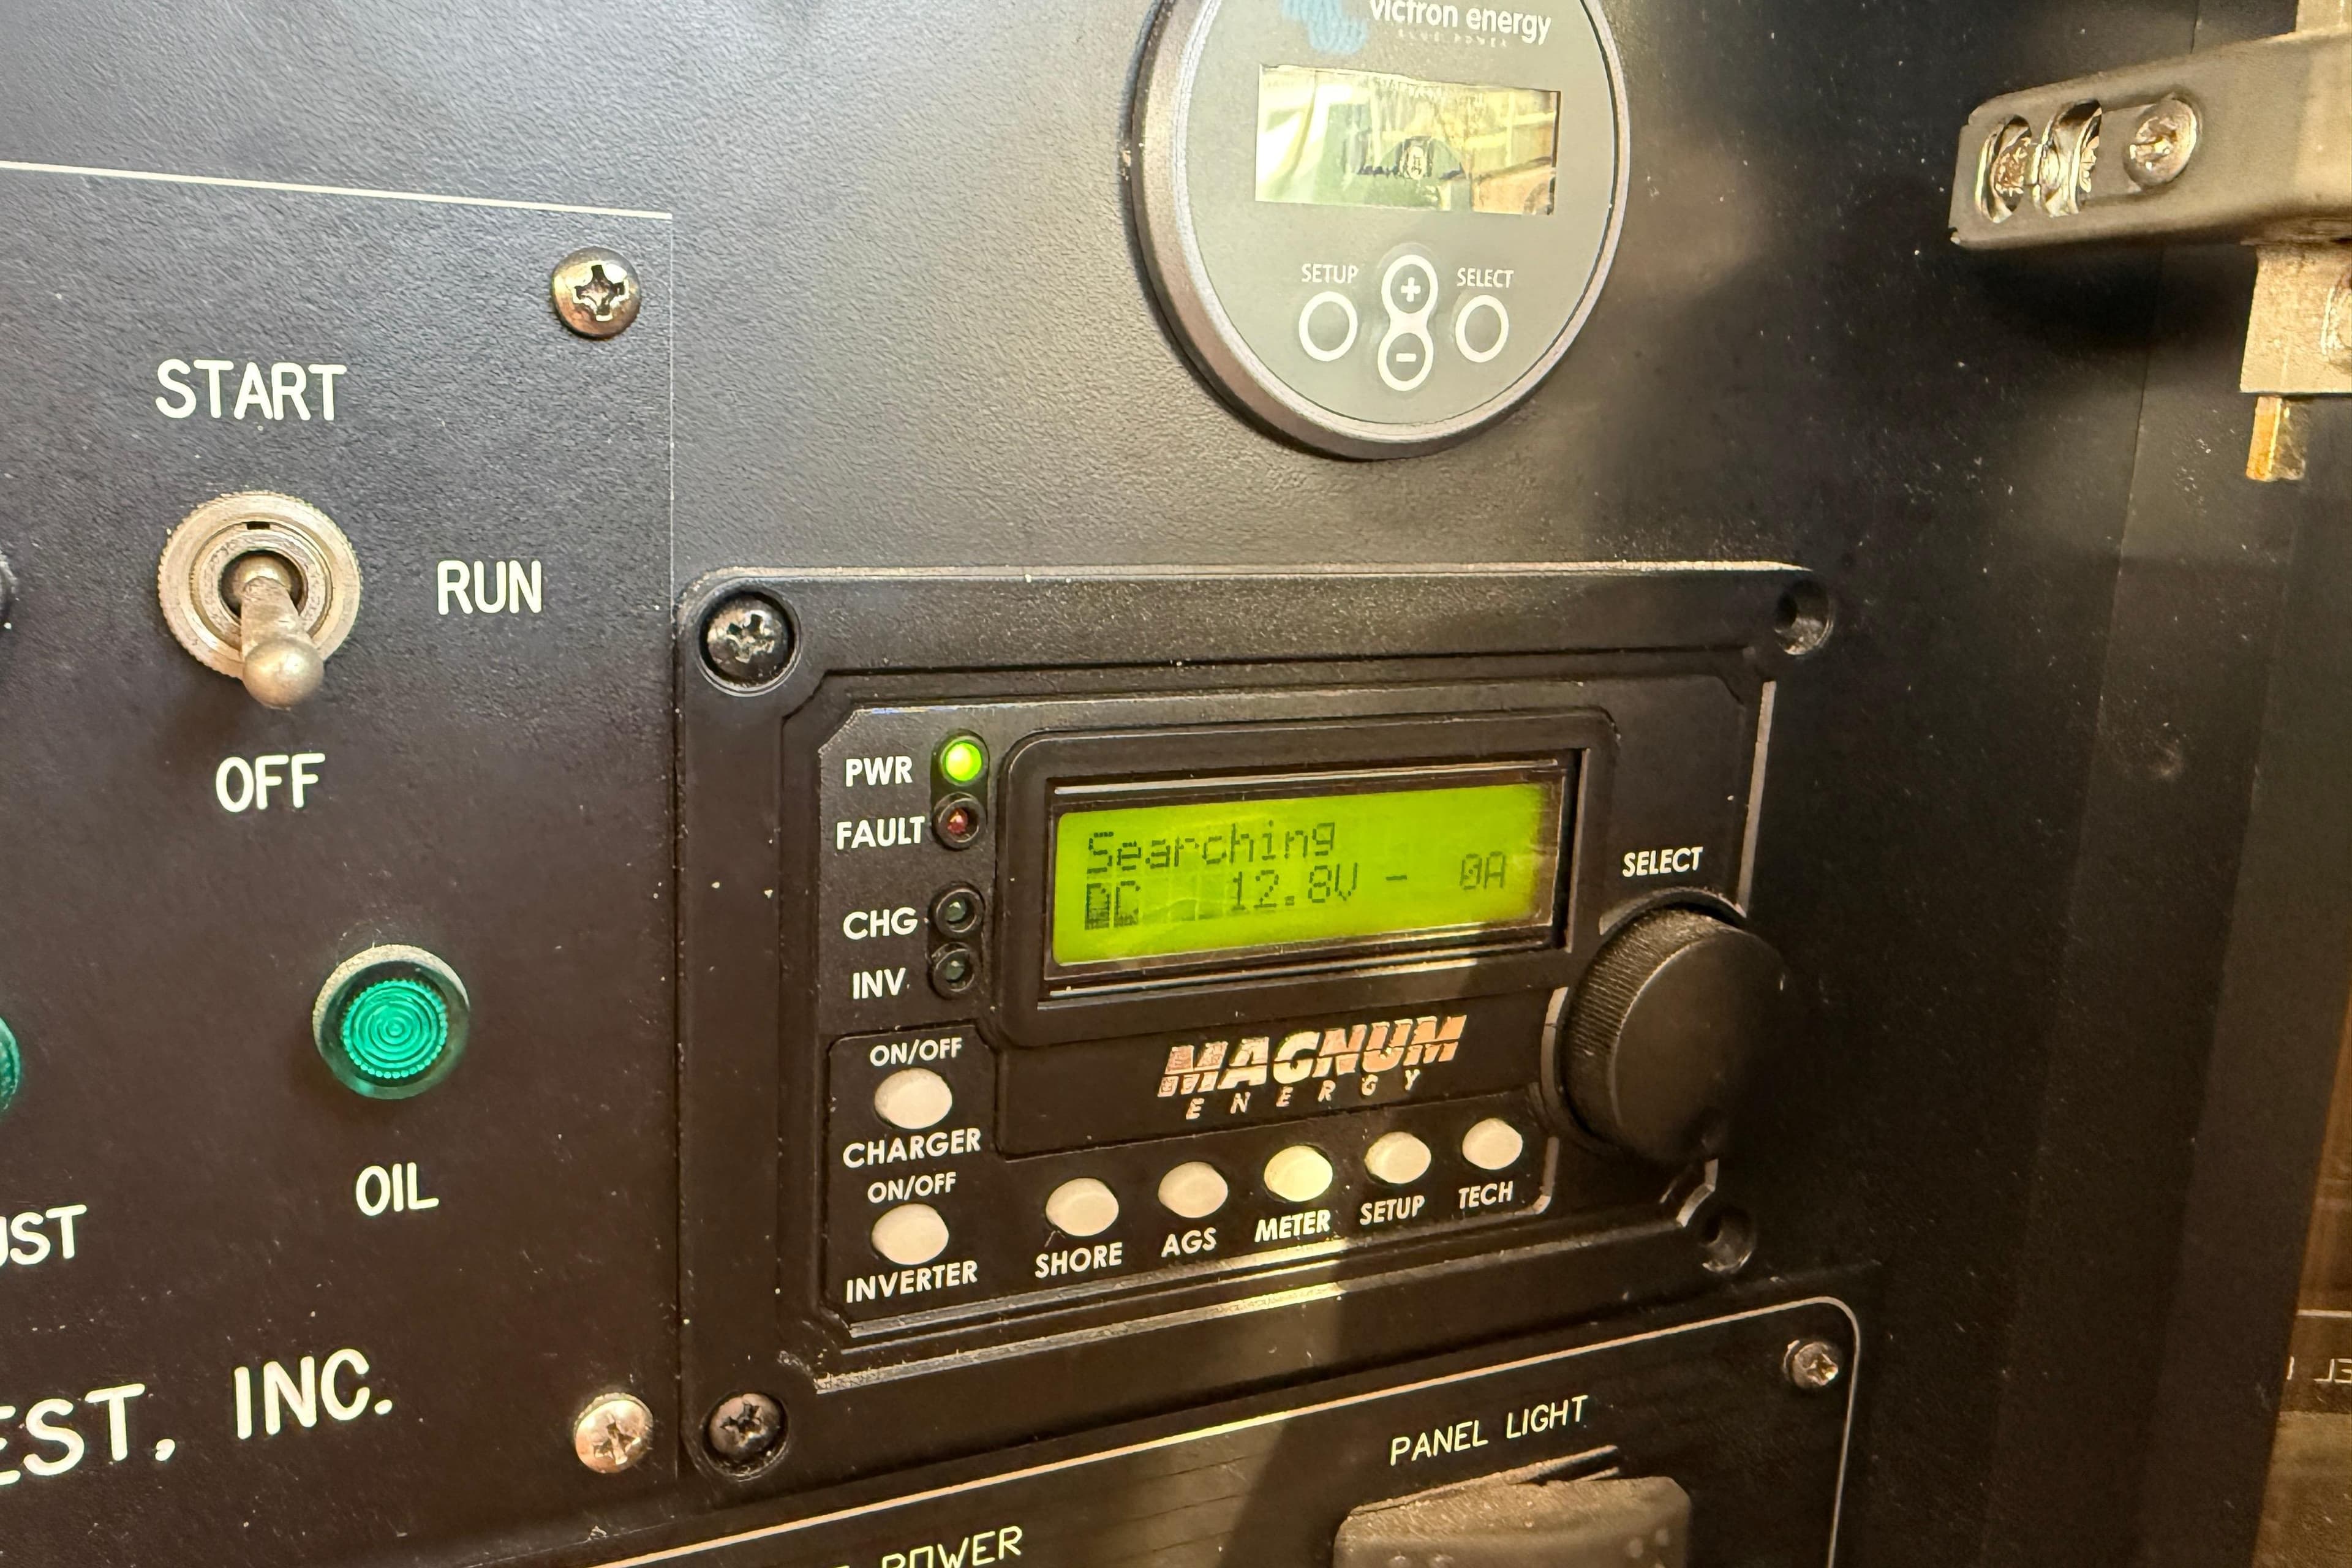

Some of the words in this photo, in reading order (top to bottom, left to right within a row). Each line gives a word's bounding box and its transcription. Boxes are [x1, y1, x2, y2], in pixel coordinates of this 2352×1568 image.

[1464, 7, 1551, 45] energy
[1301, 263, 1359, 284] SETUP
[1457, 267, 1514, 288] SELECT
[155, 358, 347, 421] START
[437, 560, 541, 615] RUN
[216, 753, 326, 813] OFF
[845, 756, 913, 787] PWR
[837, 815, 925, 850] FAULT
[1087, 820, 1335, 873] Searching
[1622, 846, 1703, 878] SELECT
[1085, 880, 1141, 929] DC
[1232, 862, 1359, 910] 12.8V
[843, 907, 918, 940] CHG
[853, 967, 906, 1000] INV
[869, 1037, 962, 1067] ON/OFF
[1157, 1014, 1468, 1098] MAGNUM
[1186, 1069, 1420, 1120] ENERGY
[843, 1128, 981, 1168] CHARGER
[355, 1162, 439, 1216] OIL
[867, 1171, 957, 1204] ON/OFF
[1458, 1180, 1513, 1210] TECH
[1254, 1209, 1331, 1243] METER
[1359, 1195, 1425, 1226] SETUP
[0, 1204, 88, 1267] ST
[1161, 1227, 1217, 1257] AGS
[1035, 1242, 1123, 1278] SHORE
[846, 1260, 978, 1303] INVERTER
[234, 1348, 393, 1440] INC.
[1390, 1420, 1488, 1466] PANEL
[1506, 1395, 1588, 1439] LIGHT
